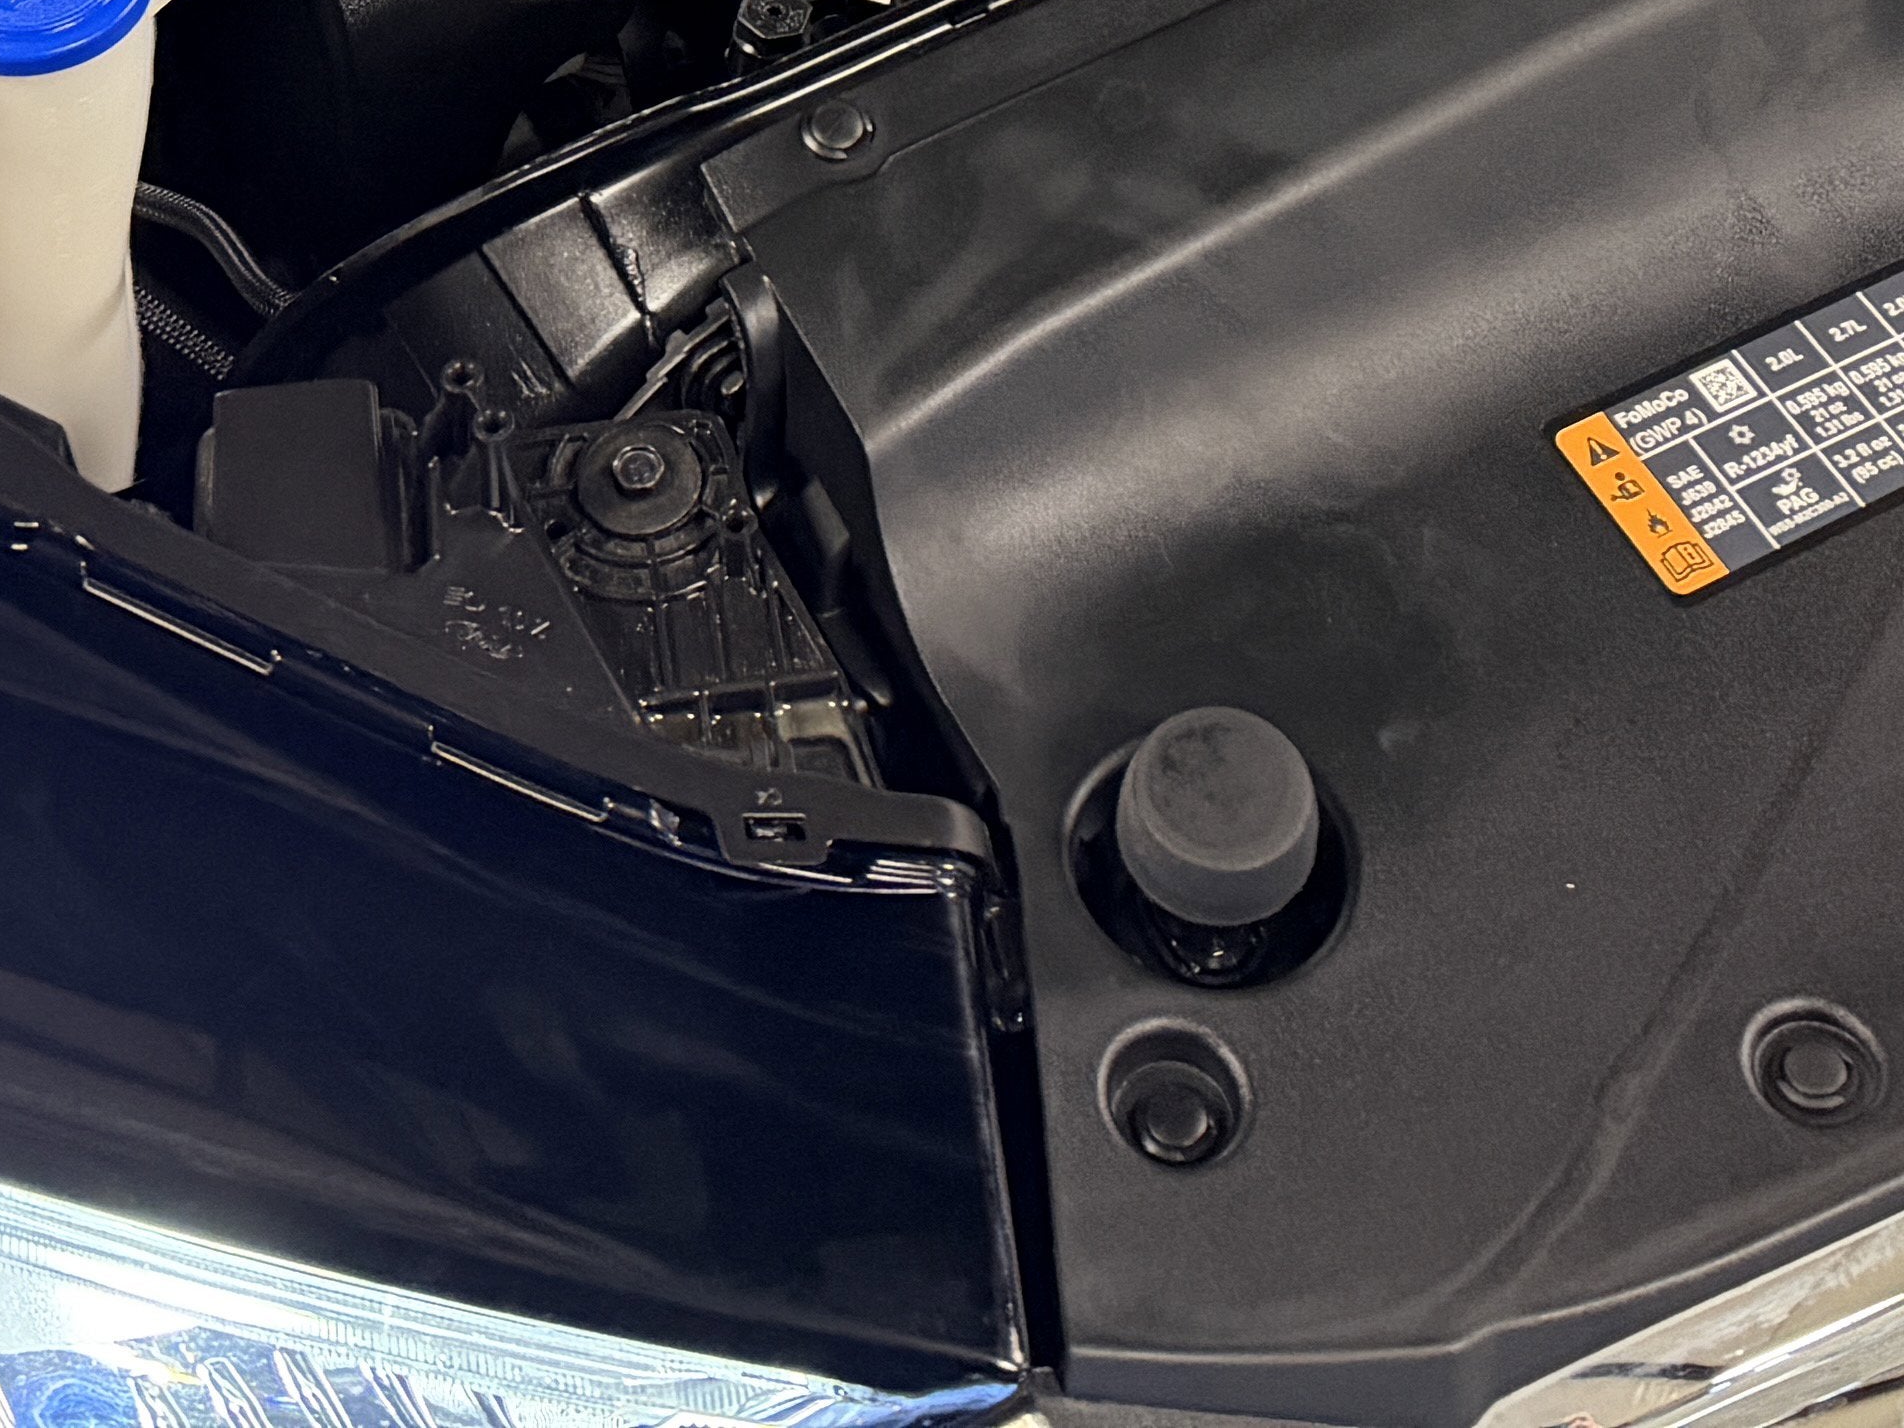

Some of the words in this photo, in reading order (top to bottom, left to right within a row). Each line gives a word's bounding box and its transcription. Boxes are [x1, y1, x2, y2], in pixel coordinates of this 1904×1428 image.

[1827, 319, 1868, 342] 2.7L
[1765, 348, 1804, 372] 2.0L
[1822, 381, 1850, 397] kg
[1613, 388, 1690, 429] FoMoCo
[1629, 417, 1682, 456] (GWP
[1684, 407, 1708, 426] 4)
[1723, 433, 1799, 479] R-1234yf
[1832, 449, 1861, 468] 3.2
[1666, 464, 1704, 489] SAE
[1776, 487, 1820, 515] PAG
